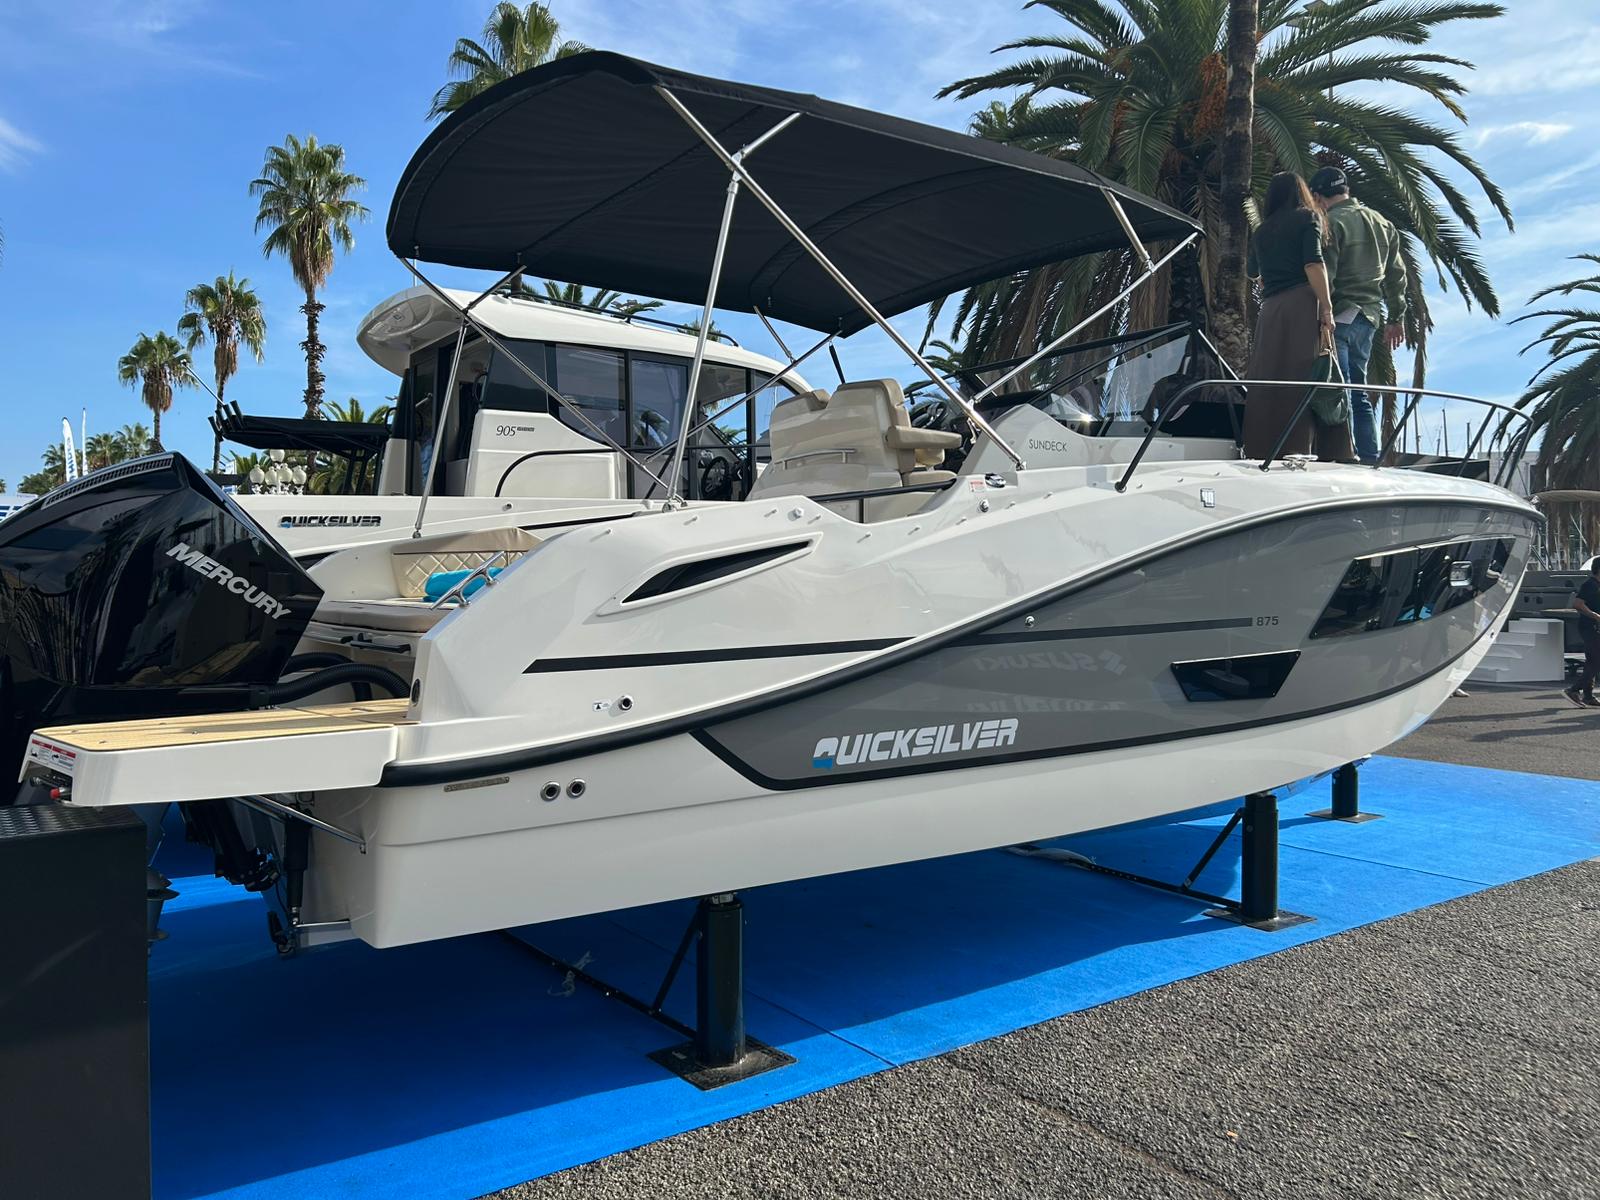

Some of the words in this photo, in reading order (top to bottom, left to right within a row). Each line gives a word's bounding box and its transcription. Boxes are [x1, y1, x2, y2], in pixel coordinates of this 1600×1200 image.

[496, 425, 516, 437] 905
[1028, 439, 1067, 452] SUNDECK
[279, 516, 382, 528] QUICKSILVER
[165, 542, 292, 620] MERCURY
[1256, 615, 1279, 627] 875
[812, 718, 1019, 770] QUICKSILVER
